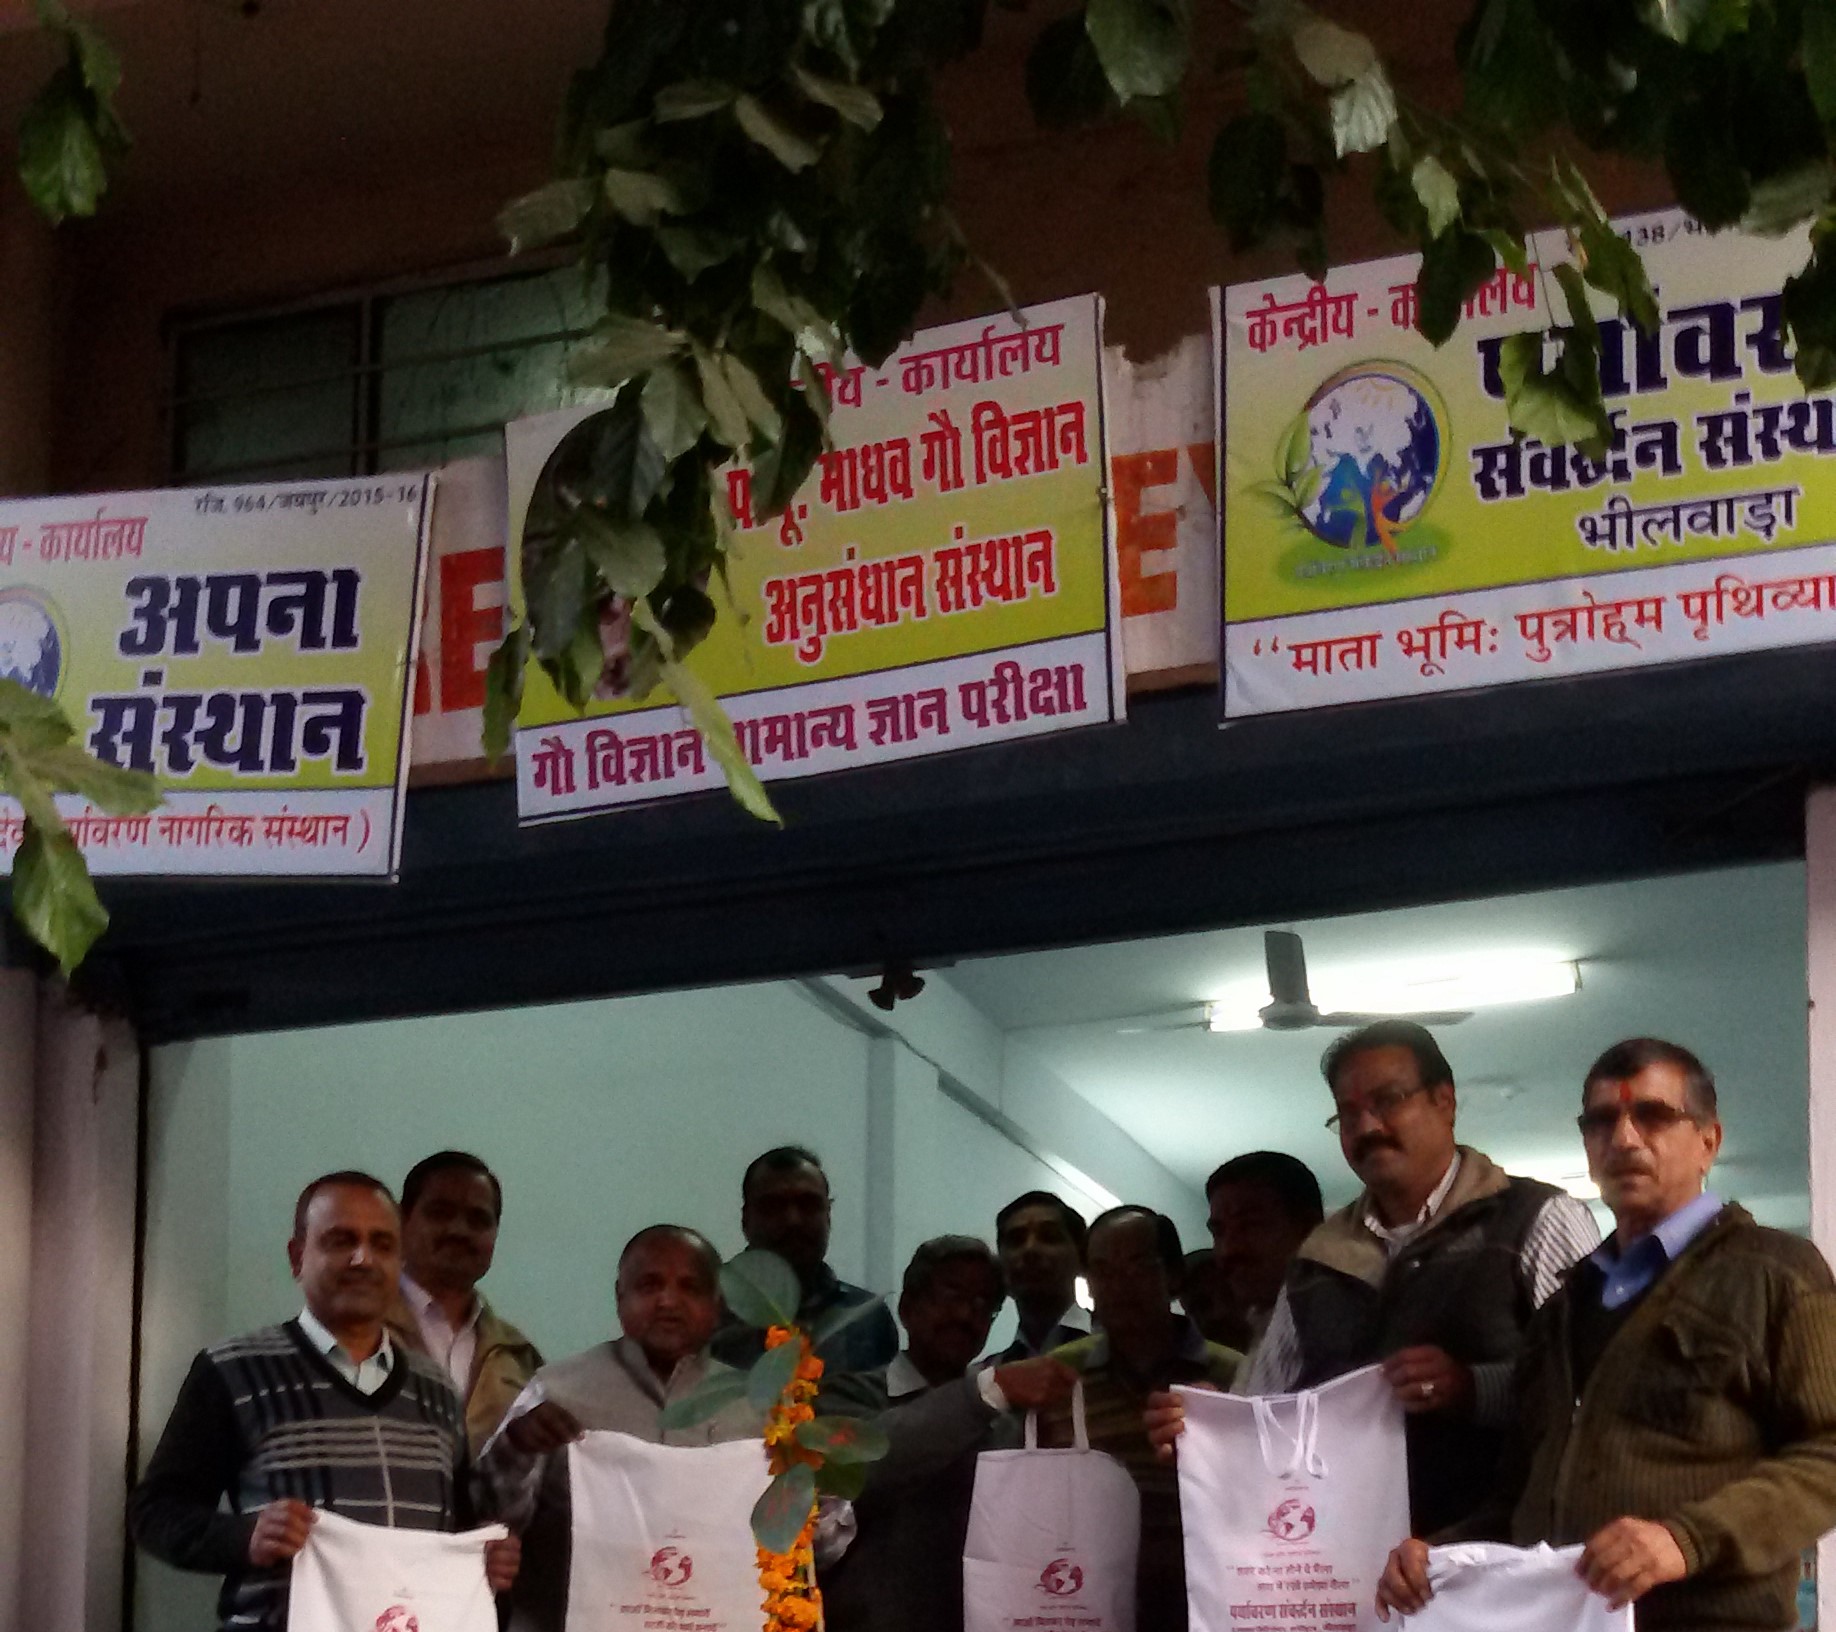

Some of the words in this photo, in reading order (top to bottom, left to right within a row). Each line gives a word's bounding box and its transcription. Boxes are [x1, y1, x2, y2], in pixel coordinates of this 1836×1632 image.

[899, 322, 1065, 396] कार्यालय
[1246, 293, 1359, 354] केन्द्रीय
[819, 436, 914, 513] माधव
[920, 408, 965, 492] गौ
[969, 399, 1088, 485] विज्ञान
[40, 506, 149, 562] कार्यालय
[1579, 486, 1801, 552] भीलवाड़ा
[118, 567, 362, 656] अपना
[765, 547, 927, 663] अनुसंधान
[934, 526, 1056, 613] संस्थान
[88, 668, 367, 774] संस्थान
[531, 736, 576, 796] गौ
[587, 728, 706, 791] विज्ञान
[866, 686, 950, 746] ज्ञान
[959, 659, 1088, 729] परीक्षा
[158, 803, 254, 848] नागरिक
[262, 804, 351, 846] संस्थान
